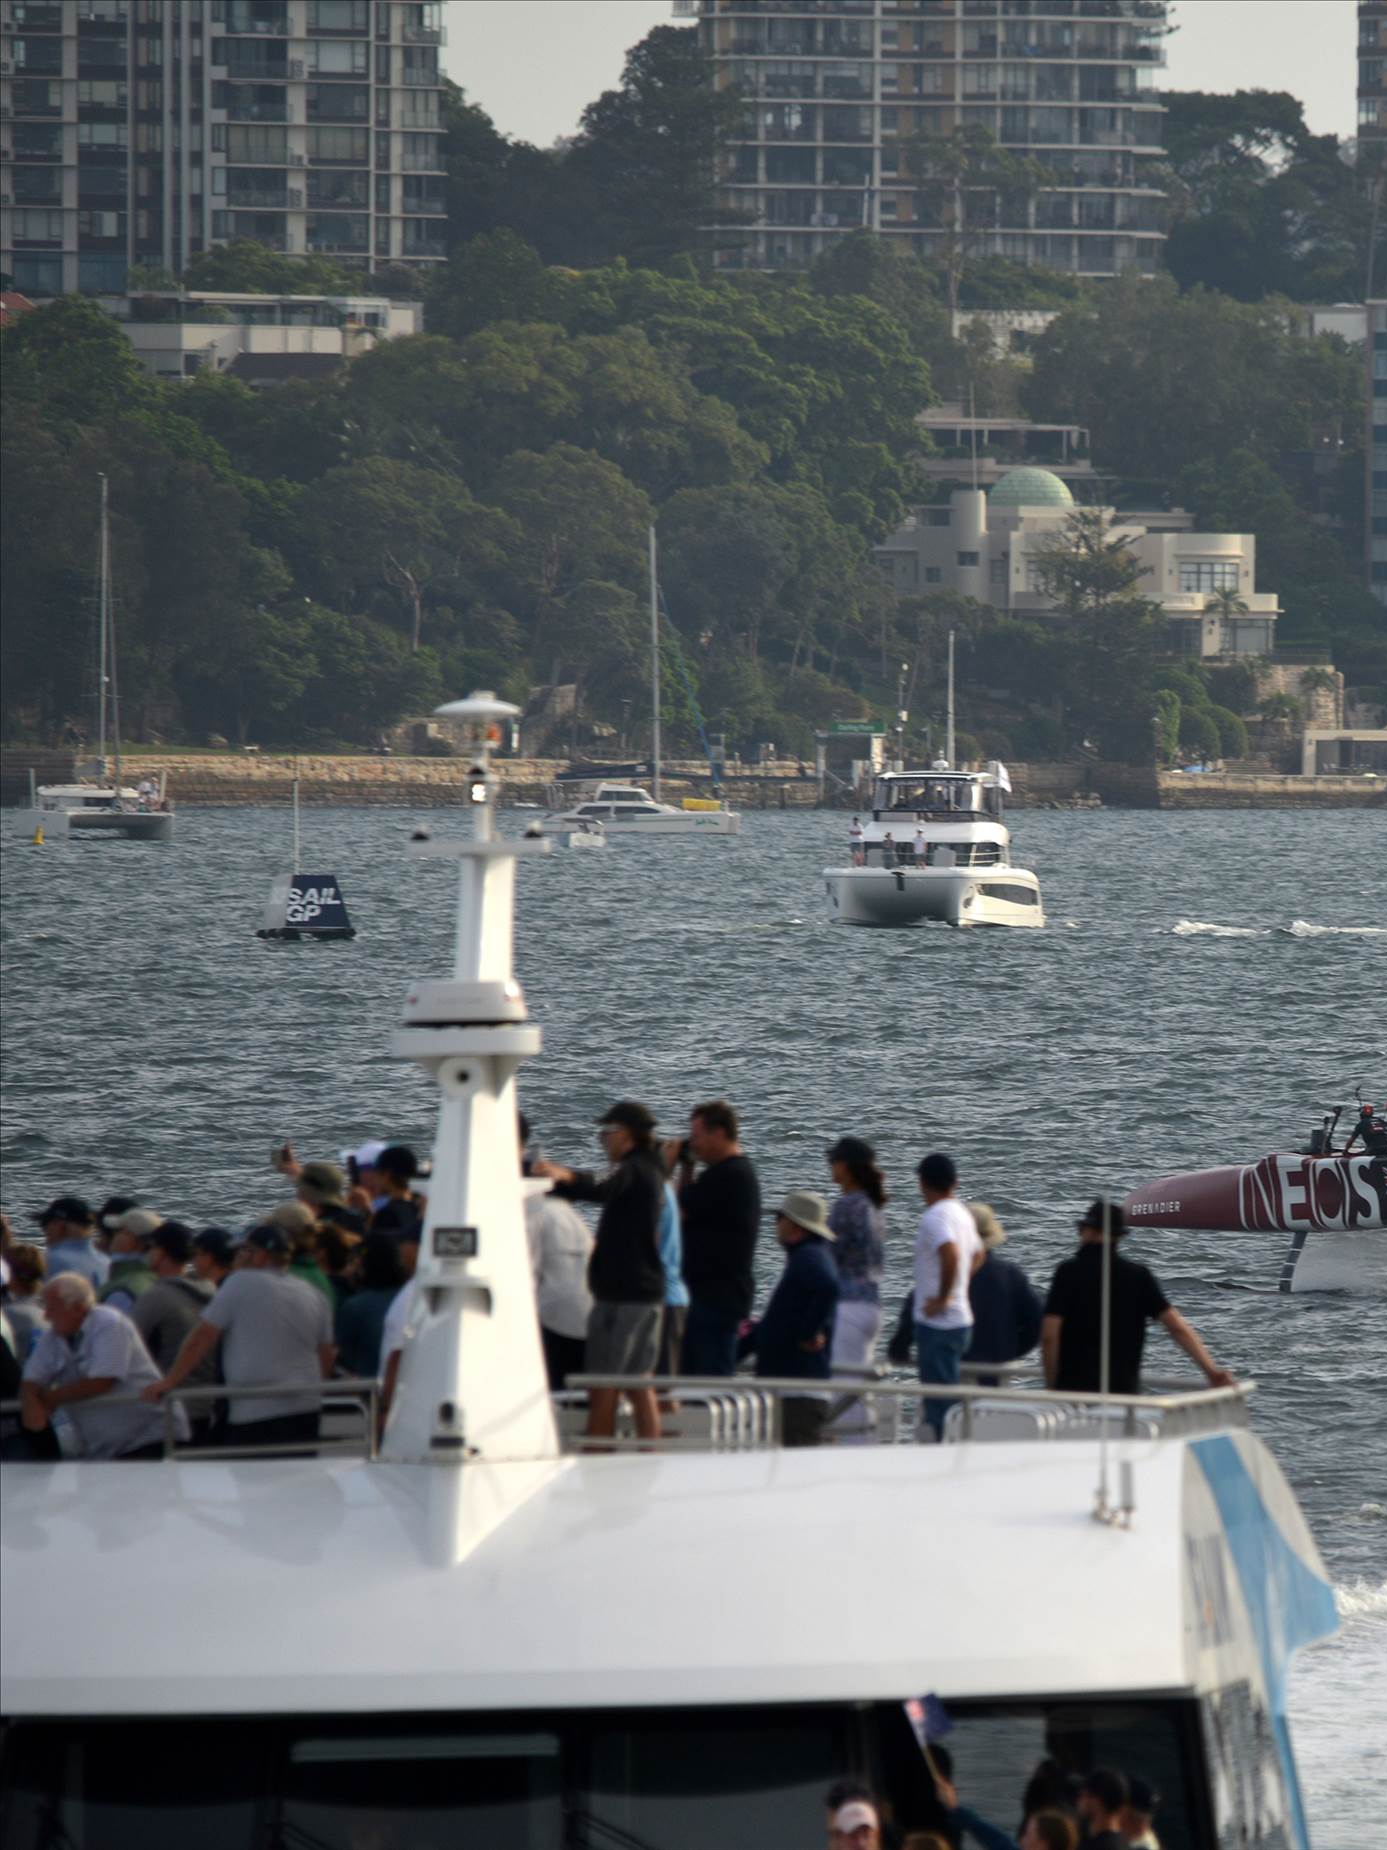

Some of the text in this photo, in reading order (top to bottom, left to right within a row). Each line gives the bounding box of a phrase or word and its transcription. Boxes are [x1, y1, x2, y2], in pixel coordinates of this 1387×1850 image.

[287, 888, 341, 905] SAIL
[286, 904, 321, 922] GP
[1131, 1201, 1181, 1216] GRENADIER
